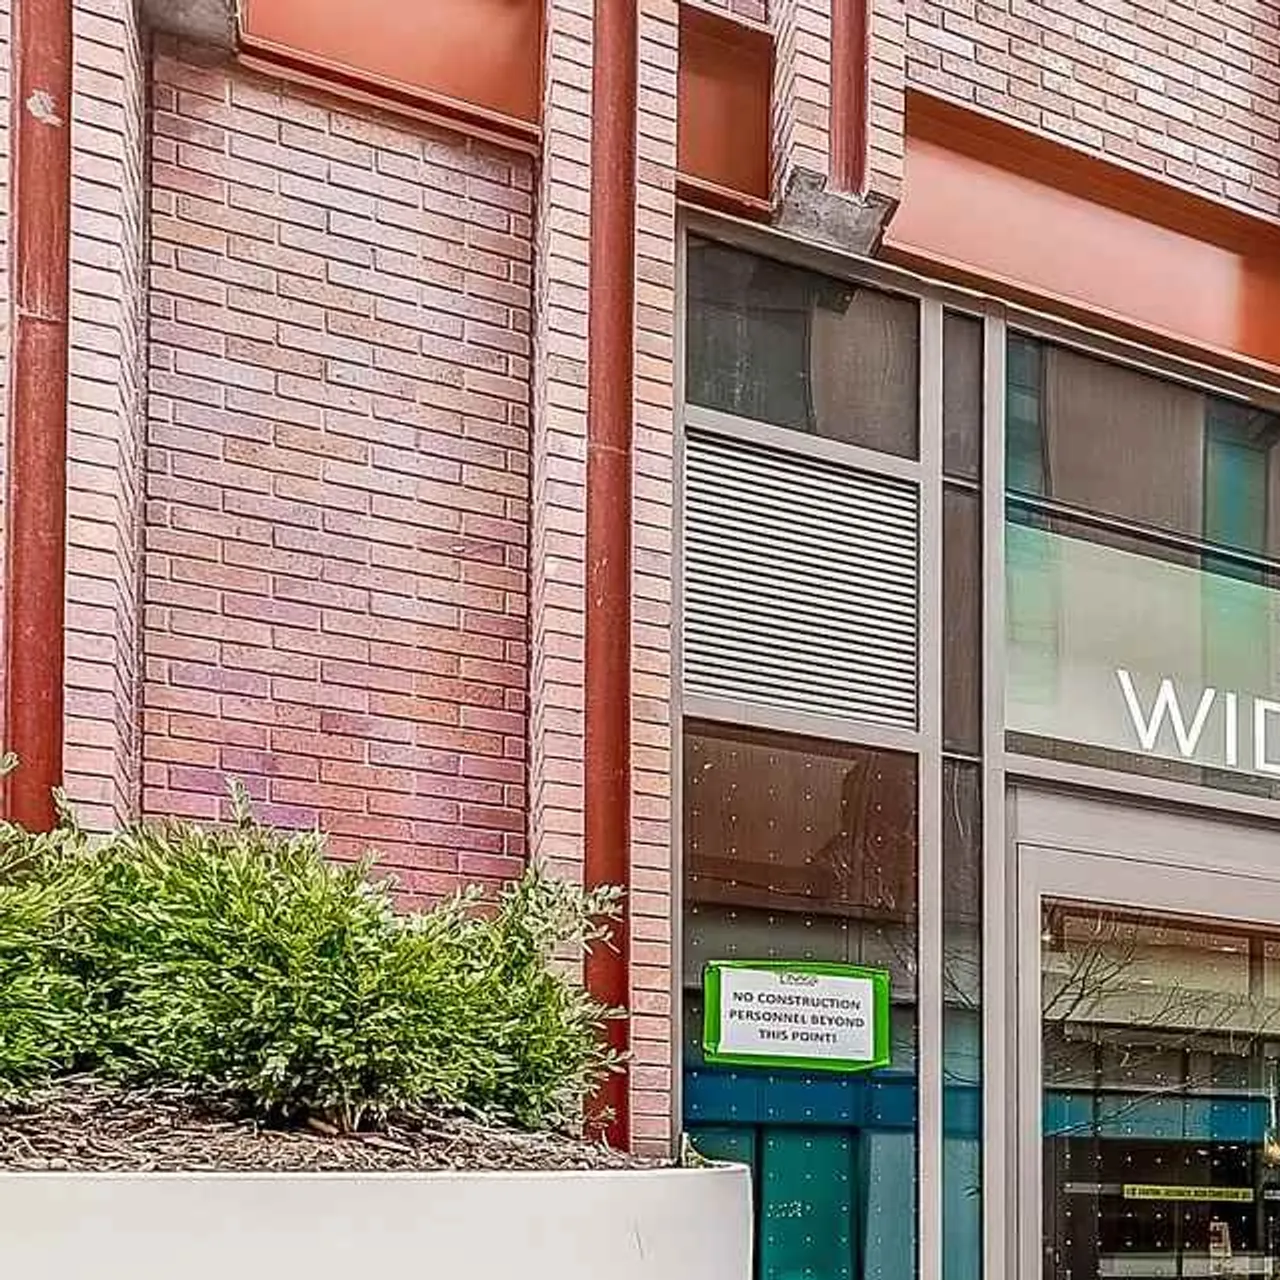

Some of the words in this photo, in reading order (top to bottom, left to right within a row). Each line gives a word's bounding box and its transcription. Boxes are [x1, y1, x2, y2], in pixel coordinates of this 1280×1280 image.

[733, 992, 754, 1003] NO
[757, 993, 861, 1010] CONSTRUCTION
[730, 1010, 807, 1025] PERSONNEL
[810, 1014, 865, 1028] BEYOND
[759, 1029, 788, 1041] THIS
